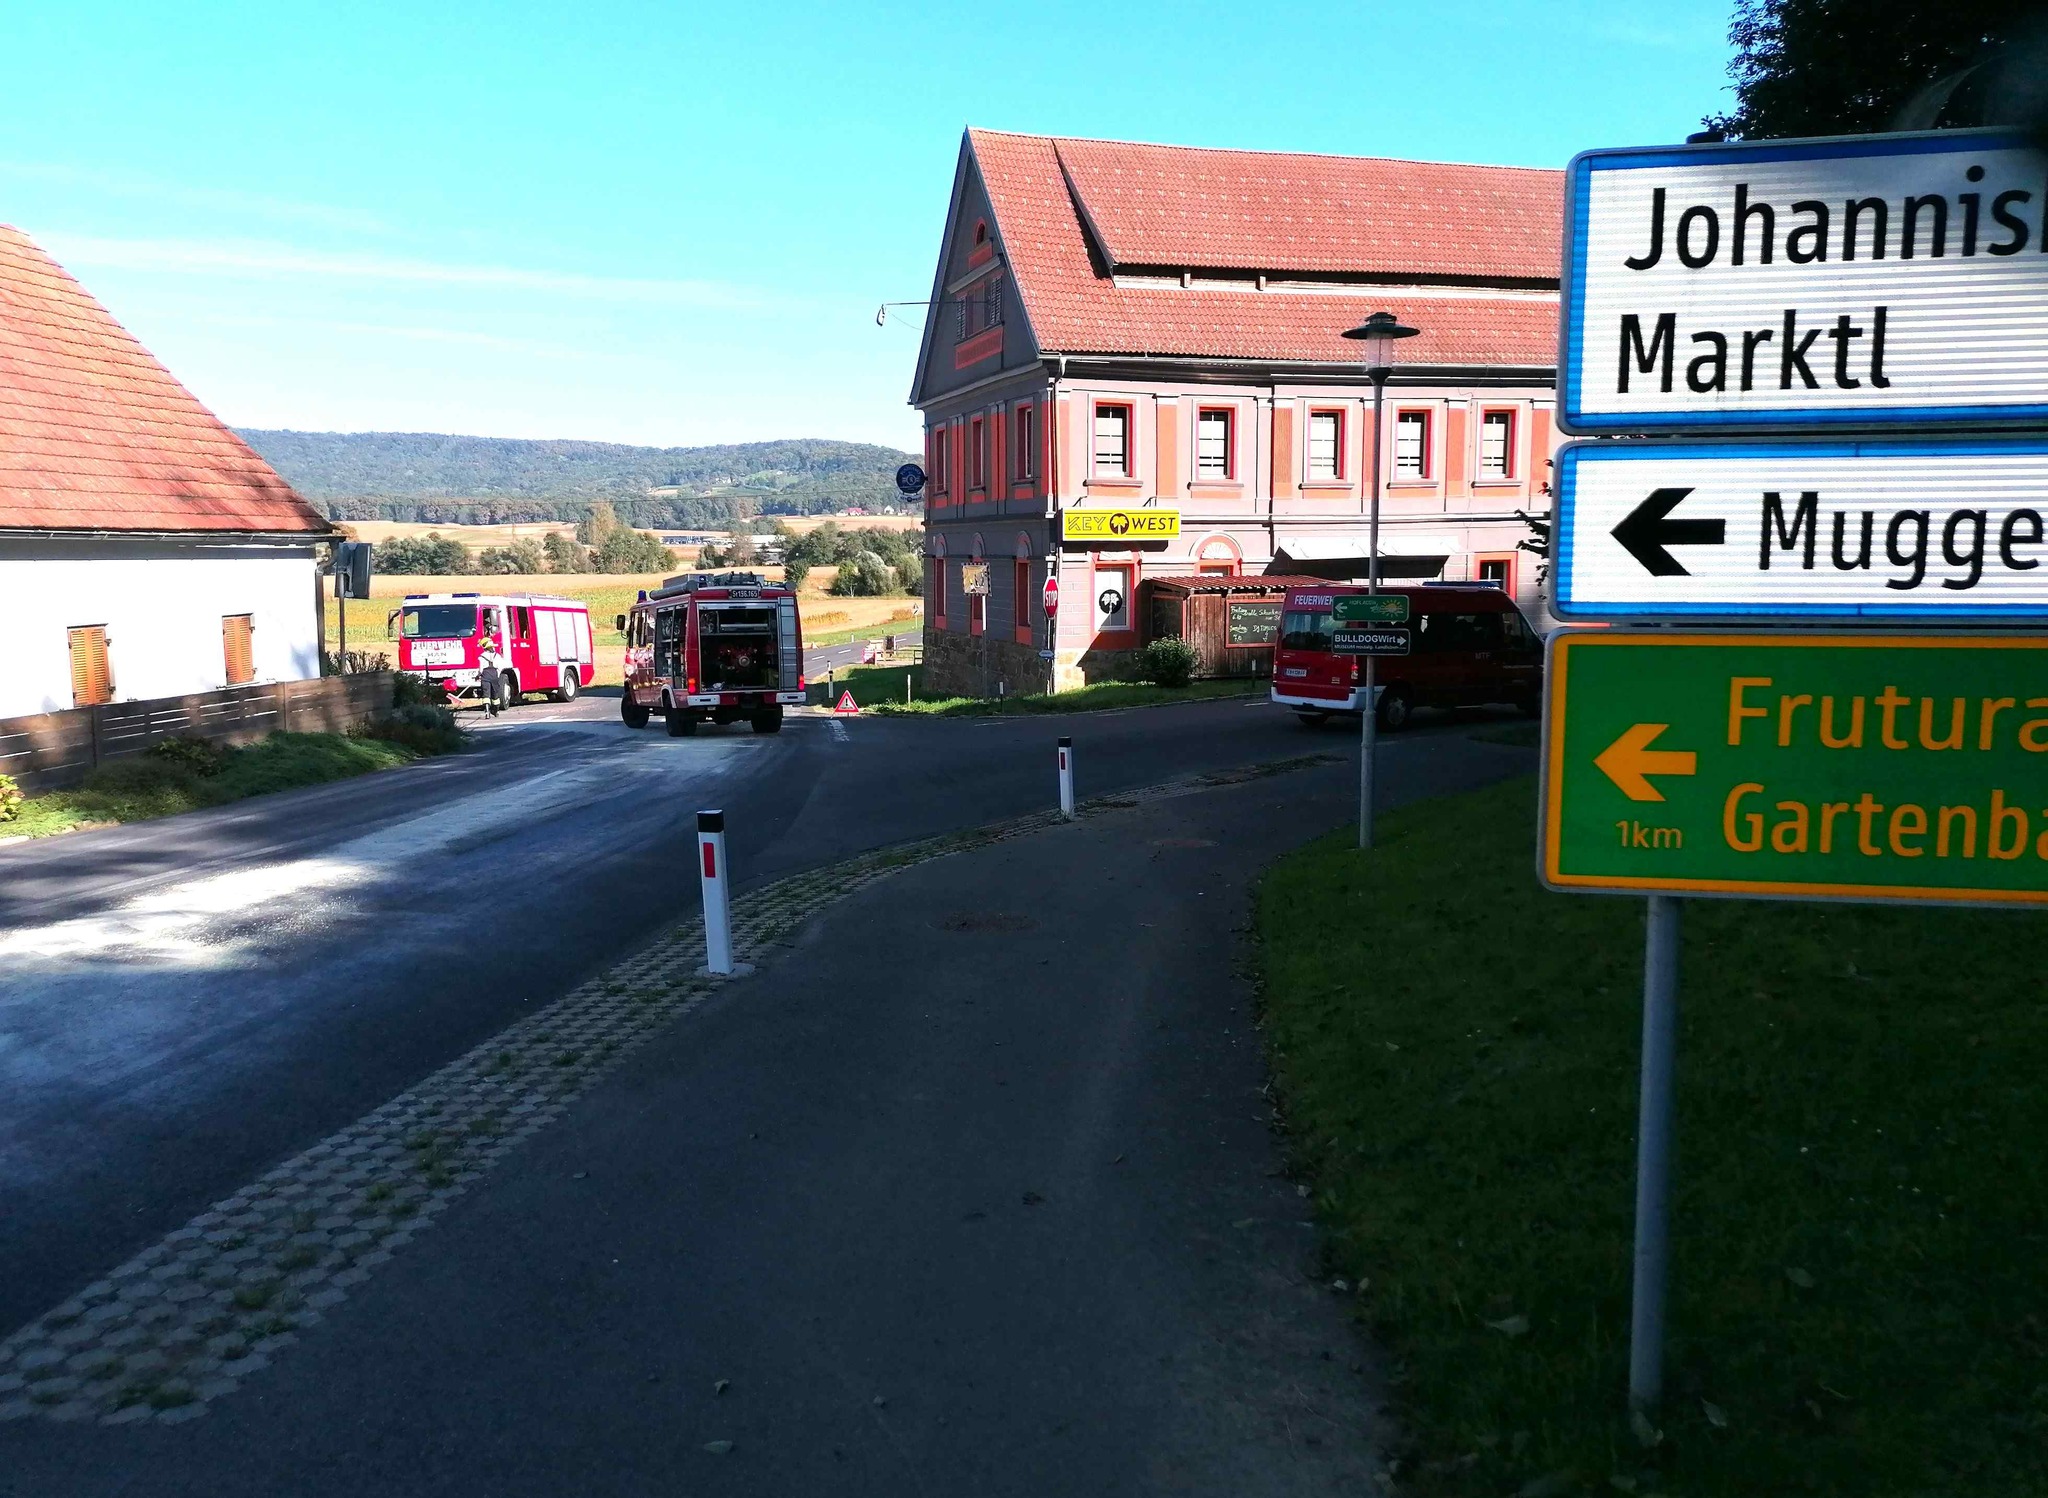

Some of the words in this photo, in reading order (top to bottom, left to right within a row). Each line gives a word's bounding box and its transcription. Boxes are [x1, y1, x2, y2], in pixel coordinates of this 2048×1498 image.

[1624, 165, 2048, 270] Johannis
[1617, 306, 1891, 393] Marktl
[1068, 516, 1106, 531] KEY
[1131, 517, 1176, 530] WEST
[1758, 491, 2044, 590] Mugge
[1045, 590, 1058, 607] STOP
[411, 639, 463, 650] FEUERWEHR
[1727, 676, 2048, 752] Frutura
[1615, 820, 1683, 849] 1km
